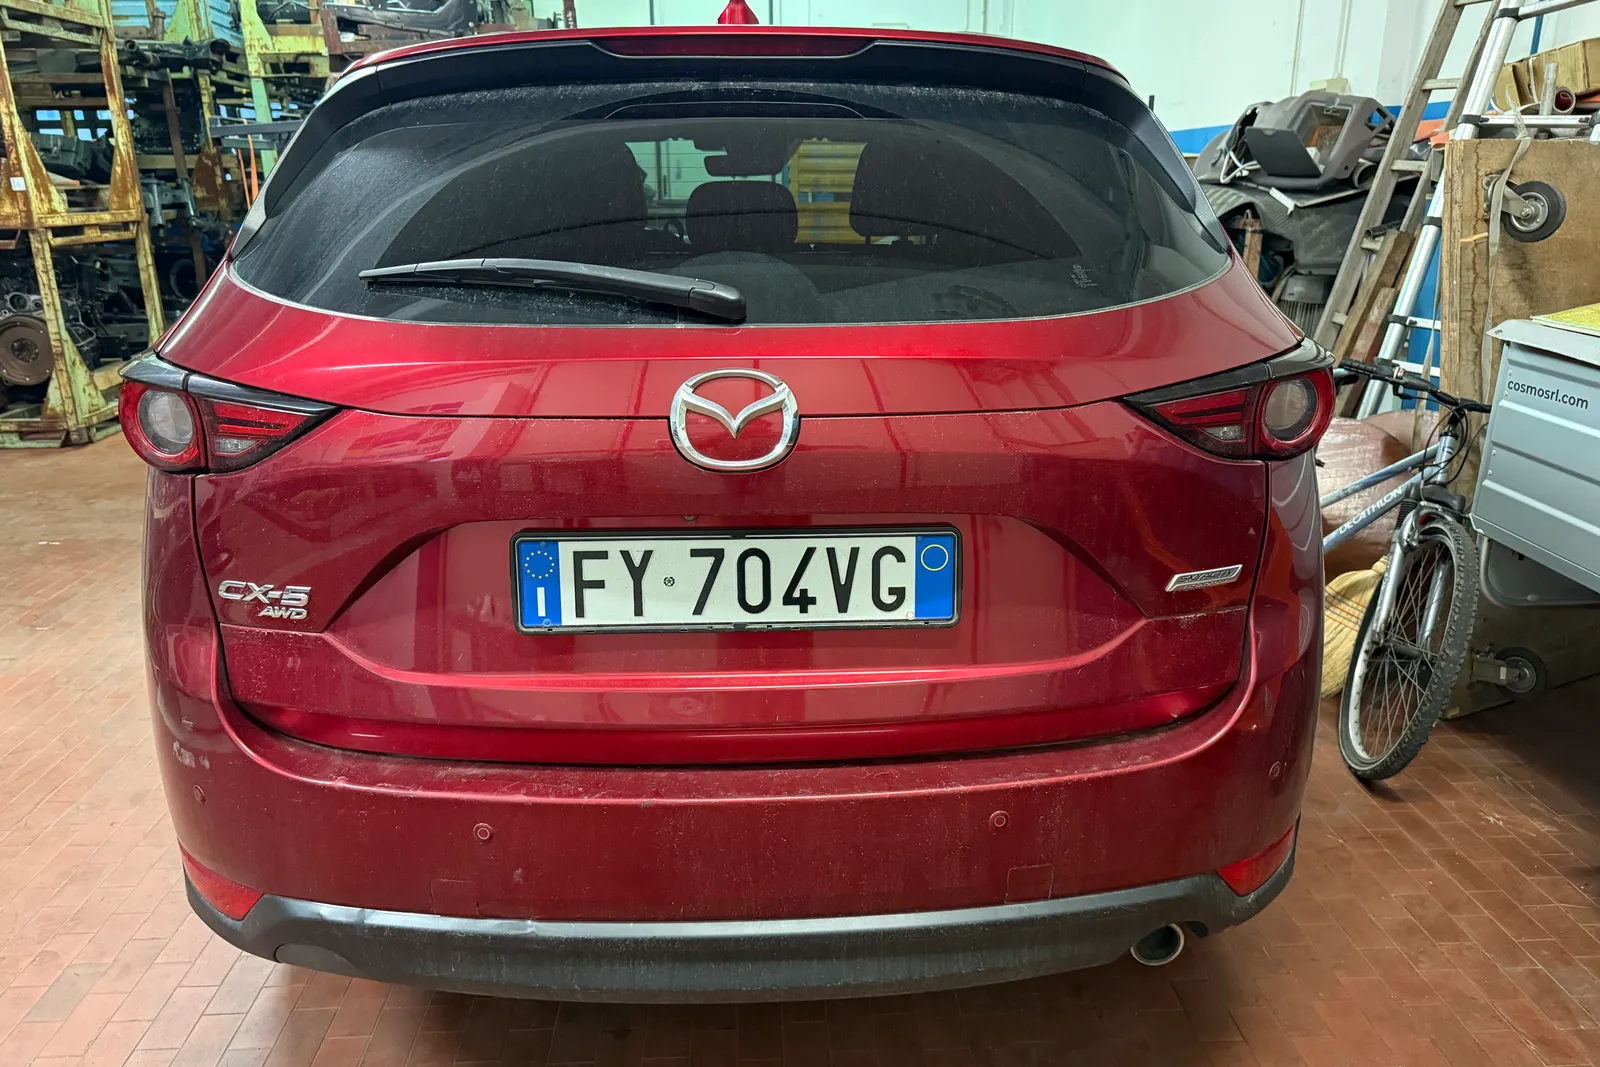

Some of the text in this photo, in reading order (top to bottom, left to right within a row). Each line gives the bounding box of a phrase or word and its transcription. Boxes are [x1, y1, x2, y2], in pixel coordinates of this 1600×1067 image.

[1507, 380, 1589, 409] cosmosrl.com
[1338, 487, 1403, 535] DECATHLON
[218, 580, 312, 607] CX-5
[572, 545, 907, 618] FY 704VG
[258, 605, 308, 620] AWD
